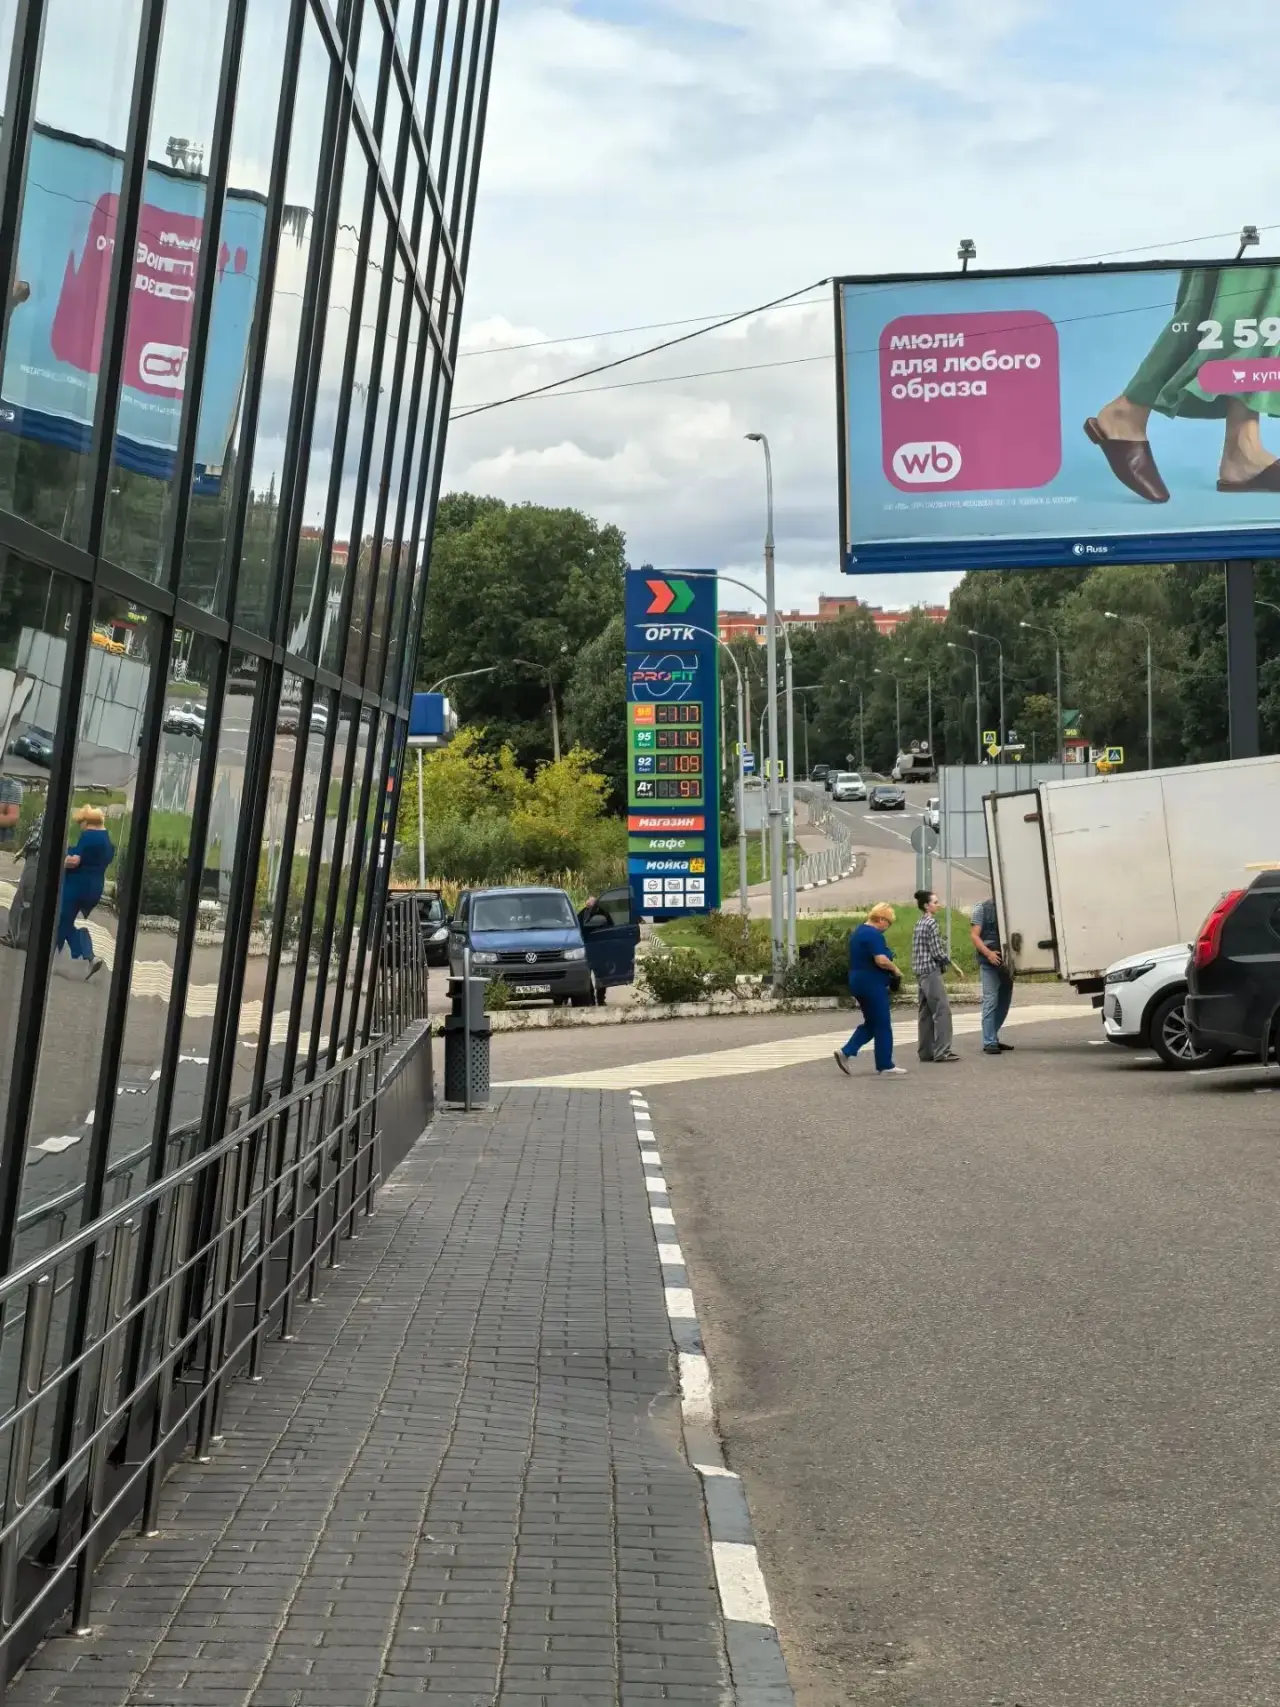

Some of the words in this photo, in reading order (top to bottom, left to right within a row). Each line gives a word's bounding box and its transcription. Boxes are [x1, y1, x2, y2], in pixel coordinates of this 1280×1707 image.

[890, 332, 965, 350] мюли
[1171, 322, 1190, 333] от
[1197, 320, 1224, 350] 2
[890, 358, 938, 377] для
[943, 349, 1041, 373] любого
[891, 377, 987, 402] образа
[900, 444, 954, 475] wb
[1086, 545, 1108, 553] Russ
[645, 627, 695, 641] ОРТК
[632, 670, 694, 681] PROFIT
[637, 731, 652, 741] 95
[637, 756, 652, 766] 92
[639, 817, 695, 827] магазин
[649, 838, 686, 850] кафе
[646, 859, 689, 870] мойка
